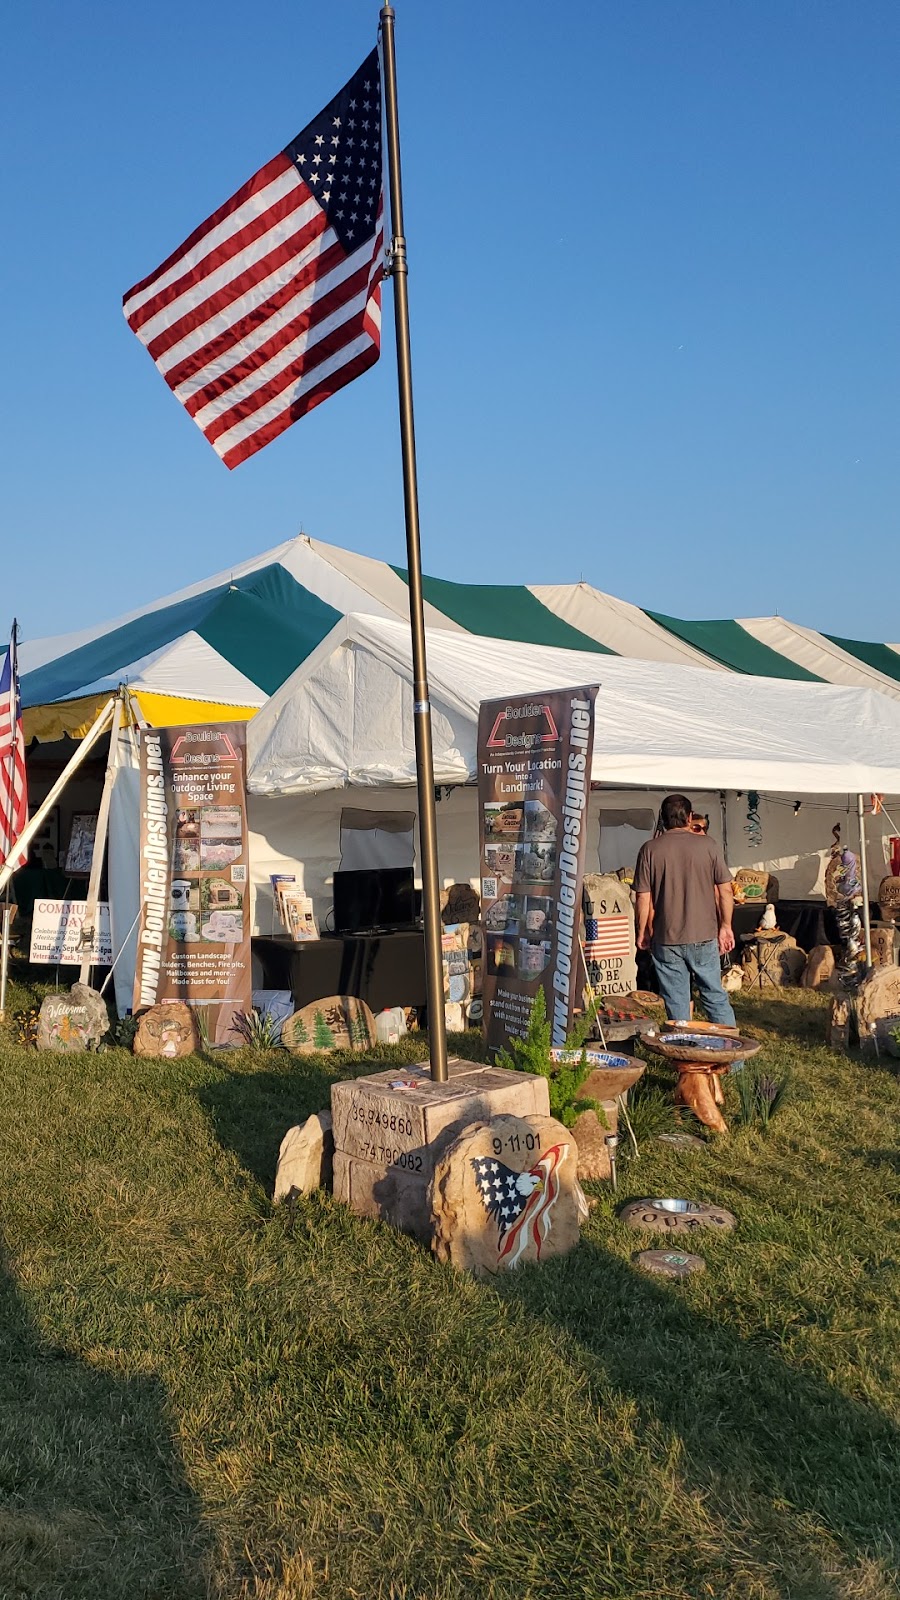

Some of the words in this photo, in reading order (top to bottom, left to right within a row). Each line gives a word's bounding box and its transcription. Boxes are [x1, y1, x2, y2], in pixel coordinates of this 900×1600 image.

[505, 703, 543, 719] Boulder
[185, 731, 221, 743] Boulder
[505, 732, 541, 748] Designs
[184, 753, 220, 765] Designs
[482, 763, 503, 774] Turn
[505, 761, 525, 773] Your
[527, 758, 562, 771] Location
[173, 773, 209, 781] Enhance
[211, 773, 232, 784] your
[515, 773, 528, 781] into
[172, 784, 205, 792] Outdoor
[207, 782, 236, 794] Living
[500, 779, 544, 793] Landmark!
[188, 793, 214, 803] Space
[552, 697, 591, 1047] ww.BoulderDesigns.net
[38, 902, 111, 916] COMMUTY
[60, 917, 85, 927] DAY
[33, 943, 61, 953] Sunday,
[197, 952, 232, 961] Landscape
[586, 957, 623, 971] PROUD
[606, 969, 620, 981] BE
[594, 980, 632, 997] ERICAN
[518, 993, 537, 1005] busine
[46, 1003, 88, 1018] Welcome
[352, 1105, 412, 1136] 39.949860
[361, 1142, 423, 1173] -74.790082
